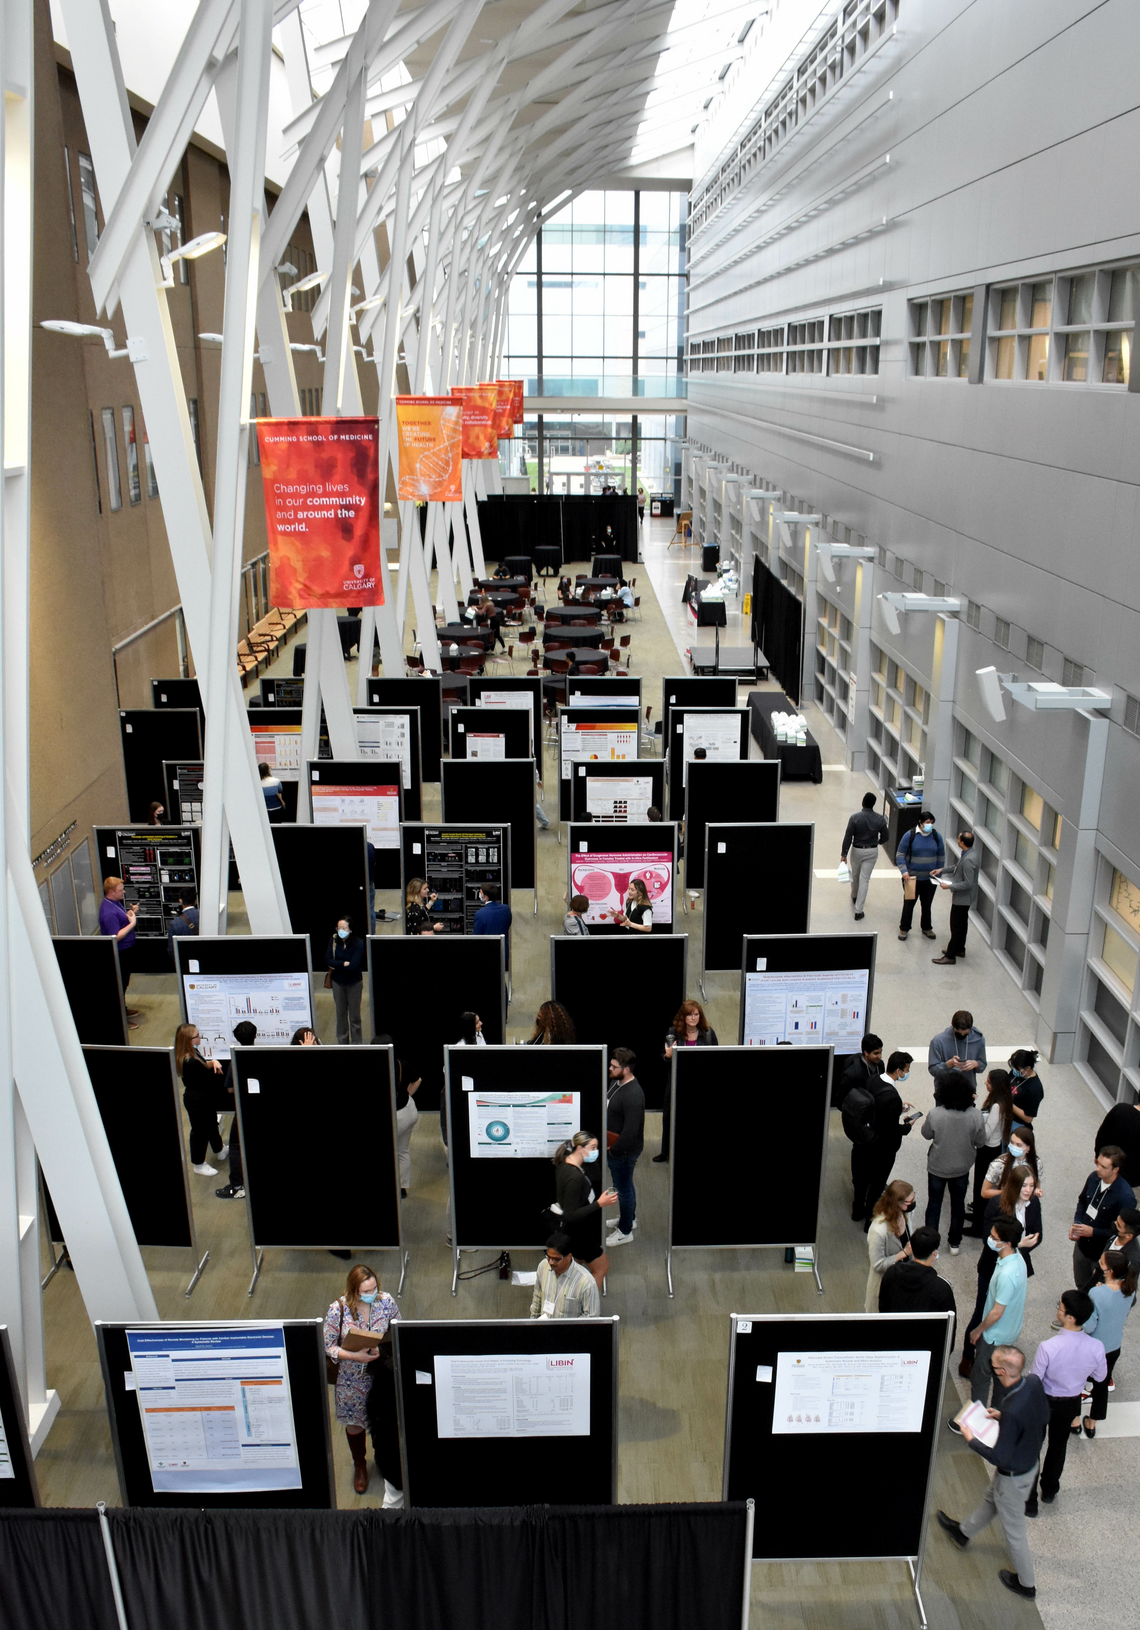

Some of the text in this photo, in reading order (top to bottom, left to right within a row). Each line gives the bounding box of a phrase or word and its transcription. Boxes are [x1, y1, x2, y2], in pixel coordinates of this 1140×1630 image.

[274, 482, 350, 494] Changing lives
[275, 496, 366, 506] in our community
[276, 508, 356, 518] and around the
[276, 522, 309, 532] world.
[343, 582, 376, 590] CALGARY
[742, 1322, 748, 1330] 2
[550, 1358, 574, 1367] LIBIN
